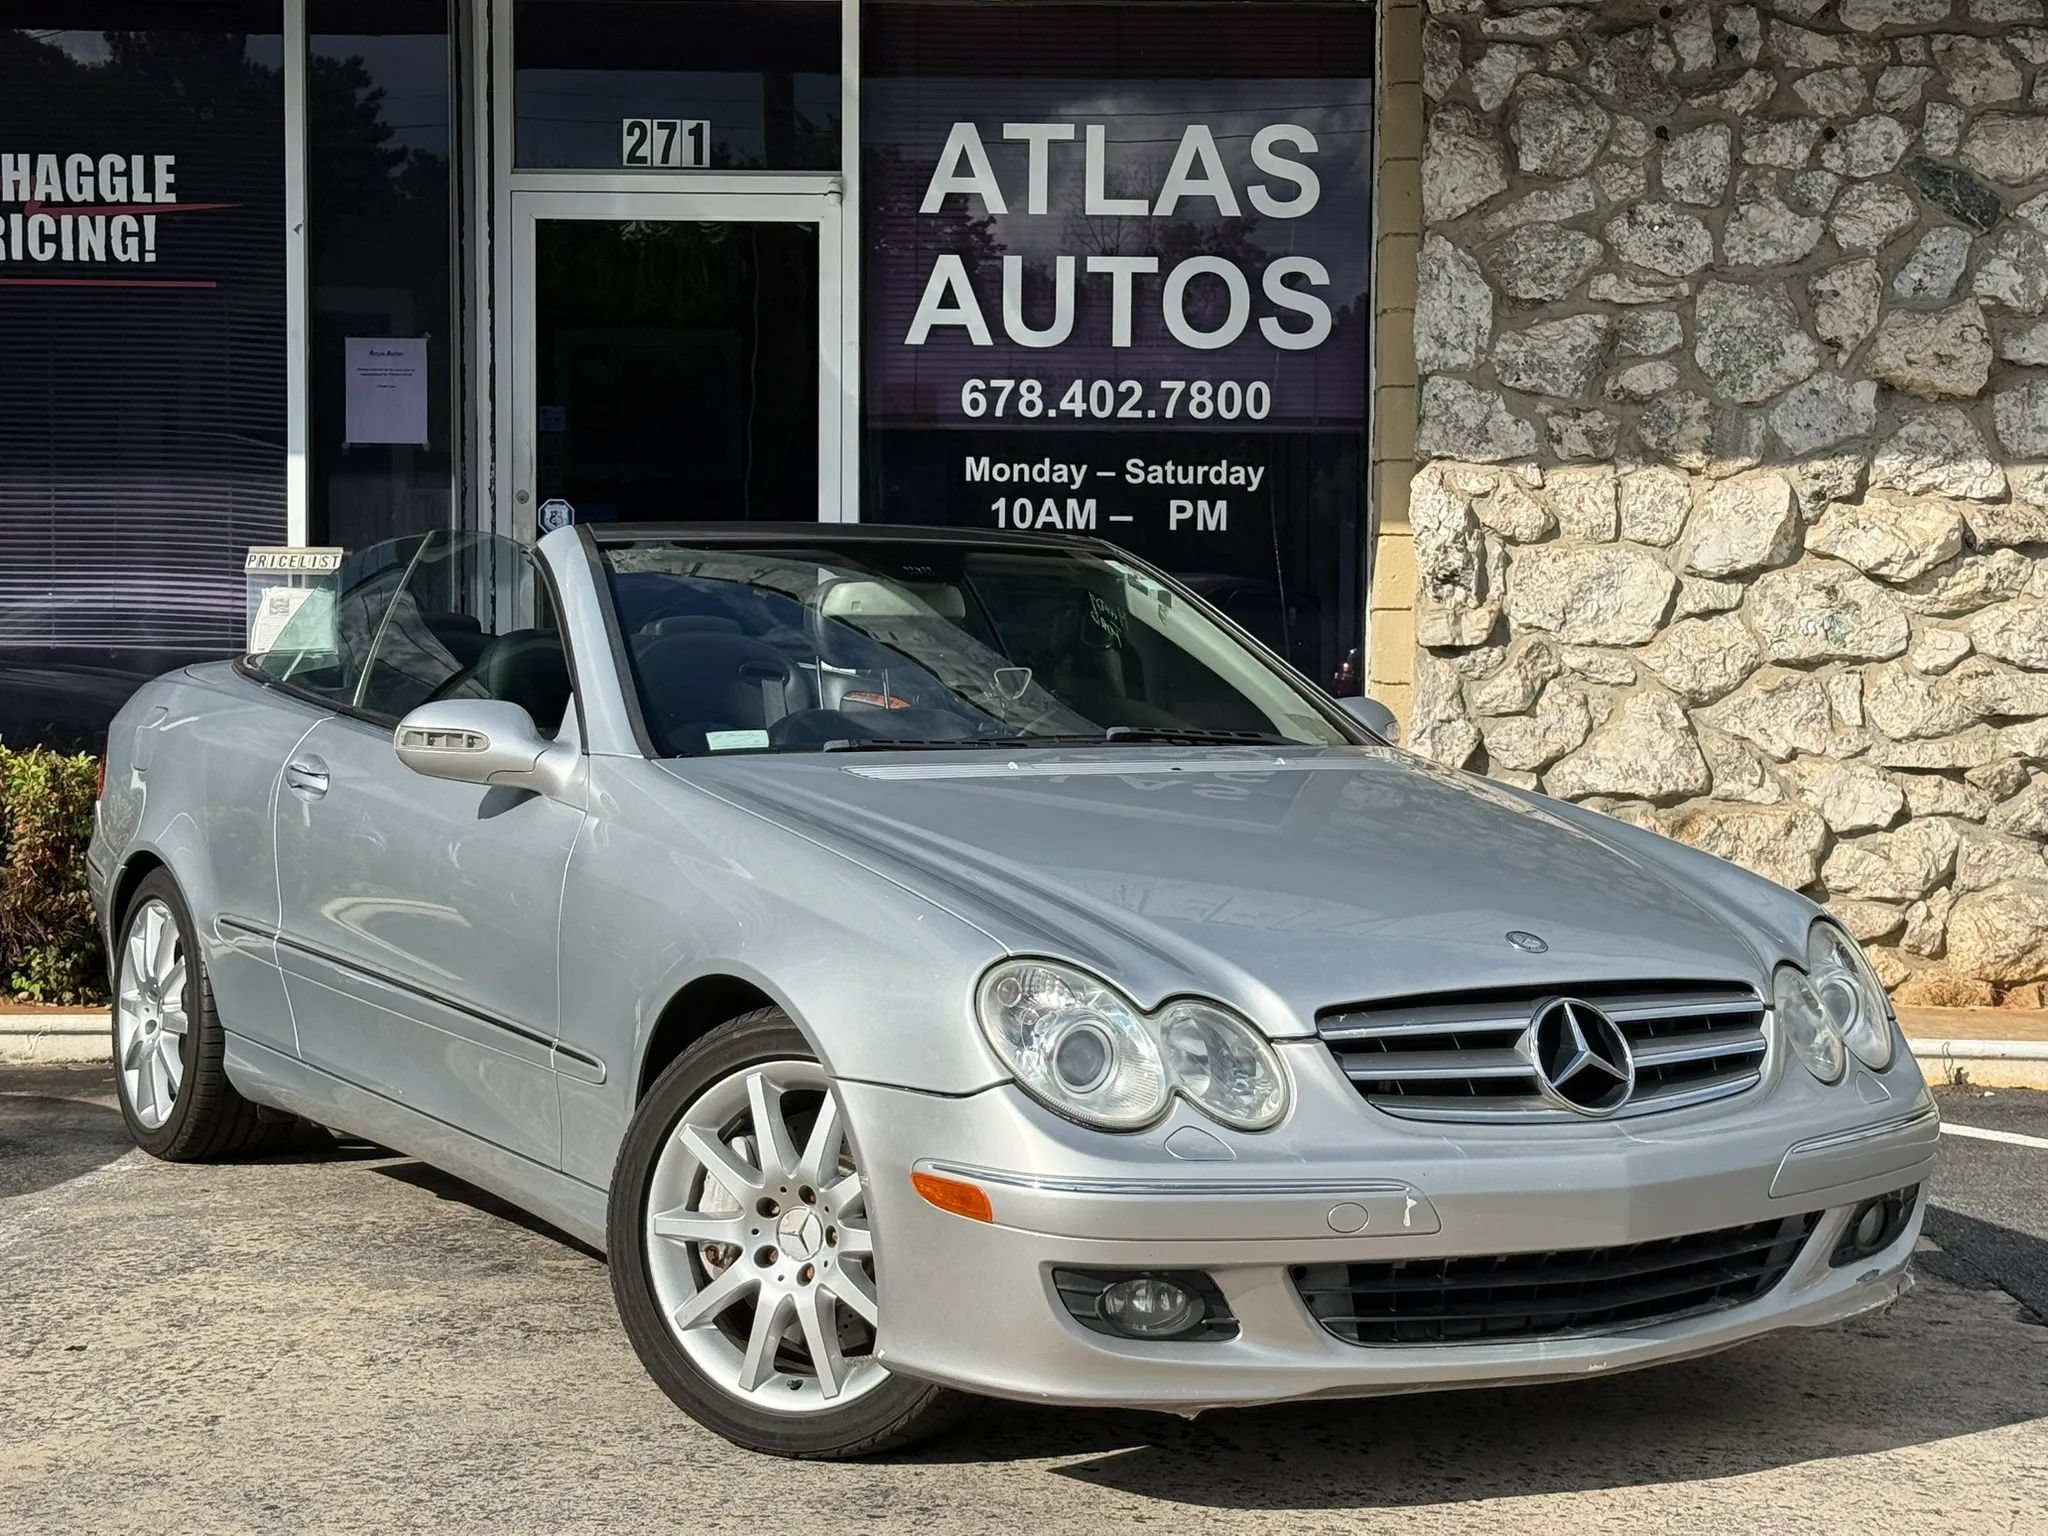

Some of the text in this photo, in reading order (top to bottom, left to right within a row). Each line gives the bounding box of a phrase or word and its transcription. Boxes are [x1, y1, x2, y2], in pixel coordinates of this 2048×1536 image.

[626, 120, 704, 166] 271
[1, 153, 177, 203] HAGGLE
[919, 122, 1319, 219] ATLAS
[0, 213, 157, 264] ICING!
[905, 254, 1332, 350] AUTOS
[961, 378, 1271, 420] 678.402.7800
[965, 456, 1088, 490] Monday
[1125, 458, 1265, 492] Saturday
[991, 497, 1097, 530] 10AM
[1169, 499, 1227, 531] PM
[247, 554, 340, 569] PRICELIST
